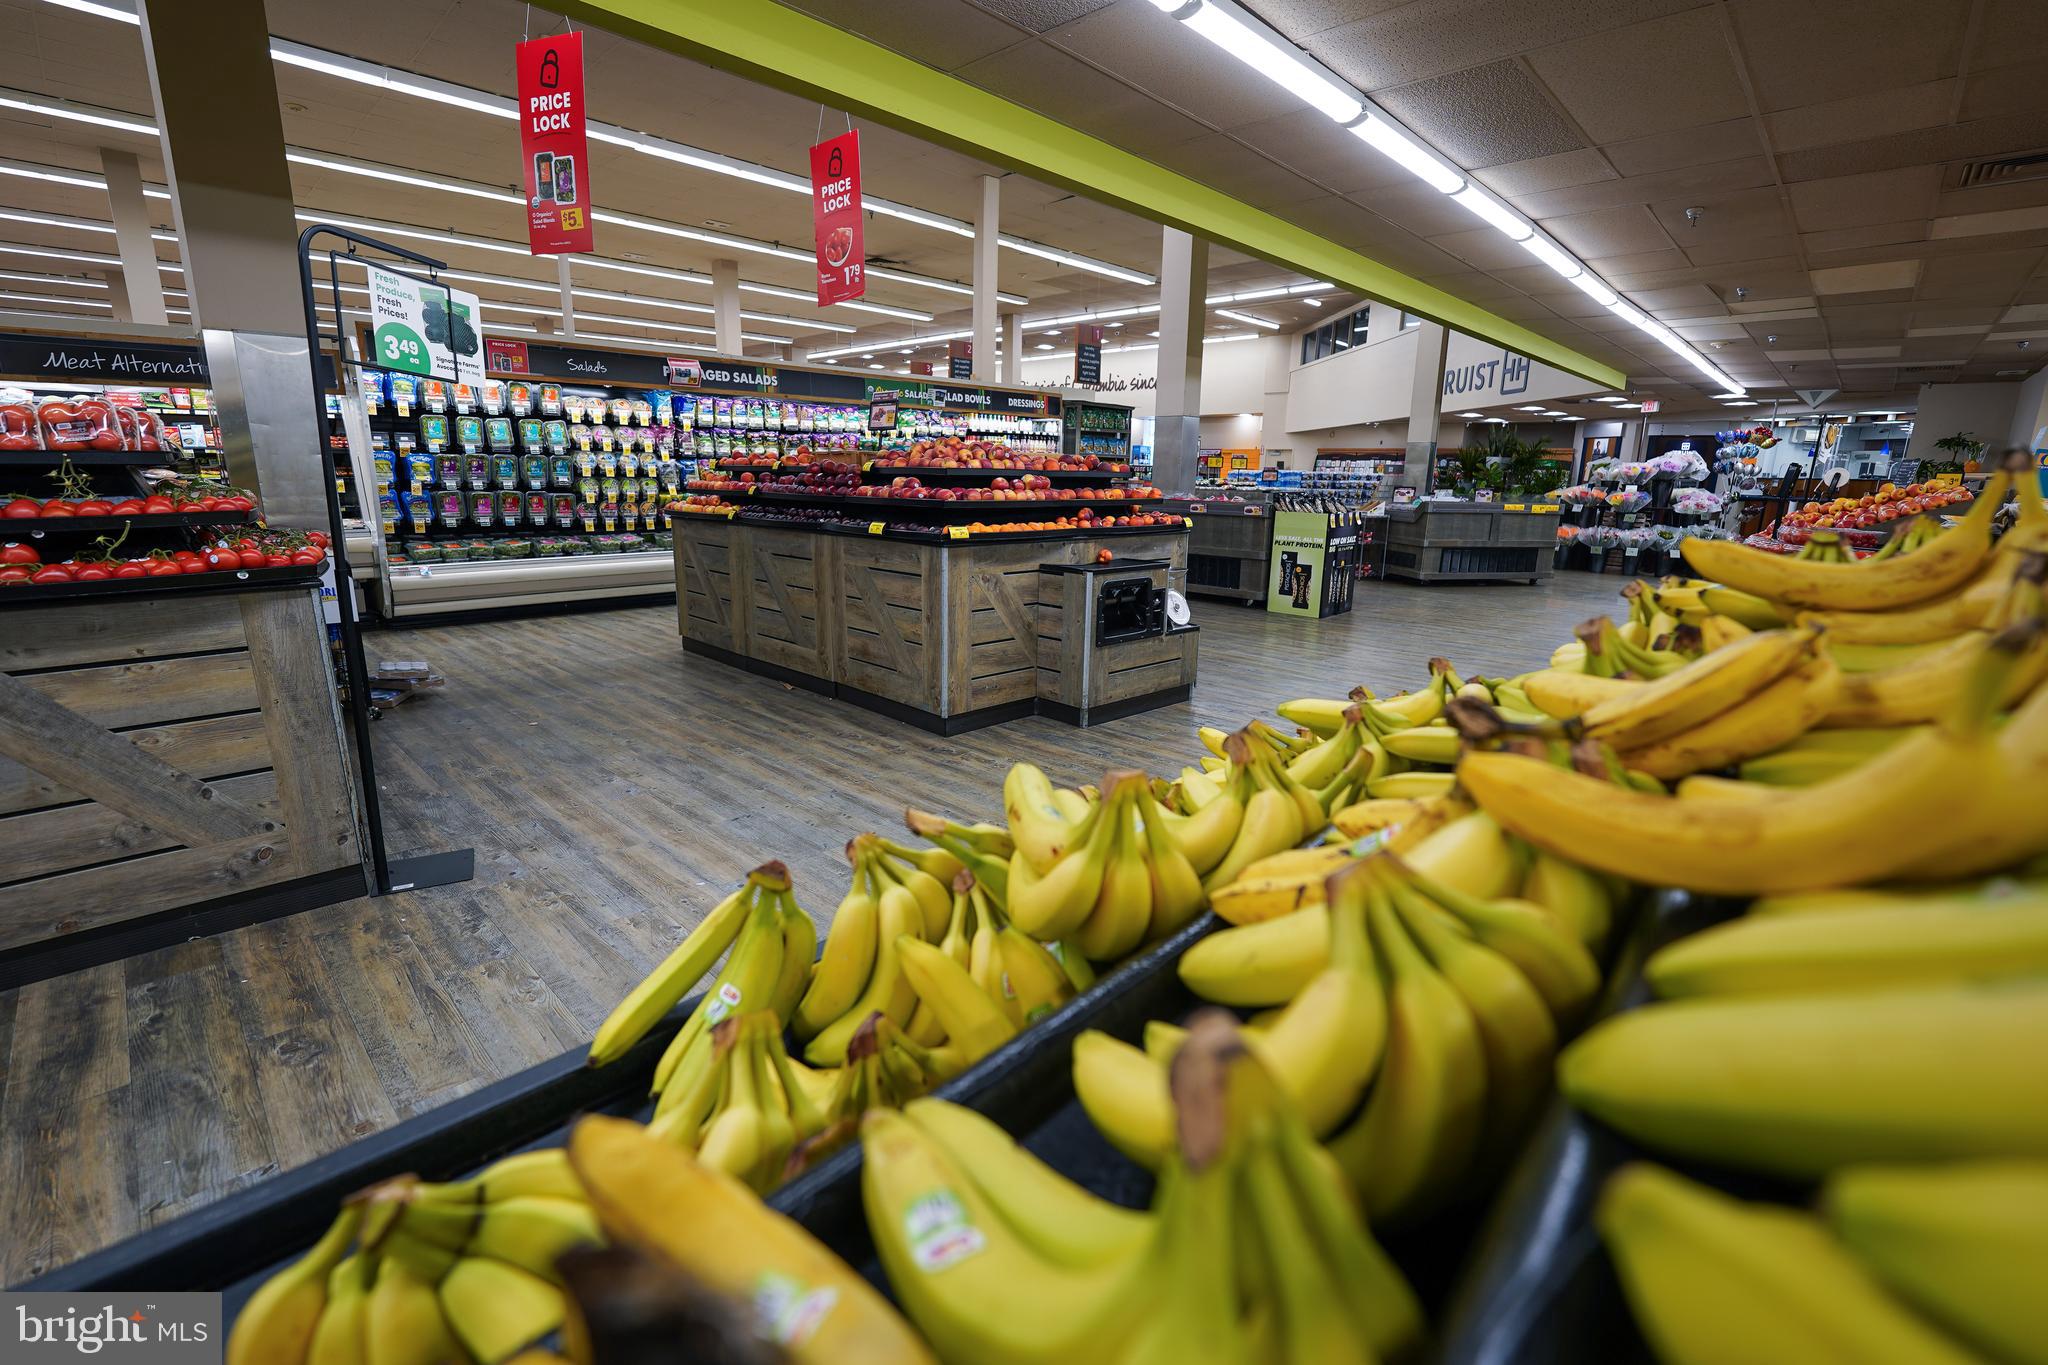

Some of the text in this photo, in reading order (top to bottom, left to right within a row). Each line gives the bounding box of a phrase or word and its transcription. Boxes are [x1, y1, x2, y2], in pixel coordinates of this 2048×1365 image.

[530, 91, 571, 113] PRICE
[533, 112, 571, 133] LOCK
[821, 177, 852, 199] PRICE
[823, 193, 851, 214] LOCK
[562, 210, 578, 227] $5
[374, 271, 400, 287] Fresh
[375, 283, 416, 303] Produce,
[377, 294, 402, 309] Fresh
[378, 305, 409, 321] Prices!
[967, 344, 972, 354] 2
[42, 352, 106, 370] Meat
[567, 358, 608, 374] Salads
[733, 371, 778, 387] SALADS
[964, 394, 991, 405] BOWLS
[1008, 397, 1045, 409] DRESSINGS
[1295, 541, 1324, 550] PROTEIN.
